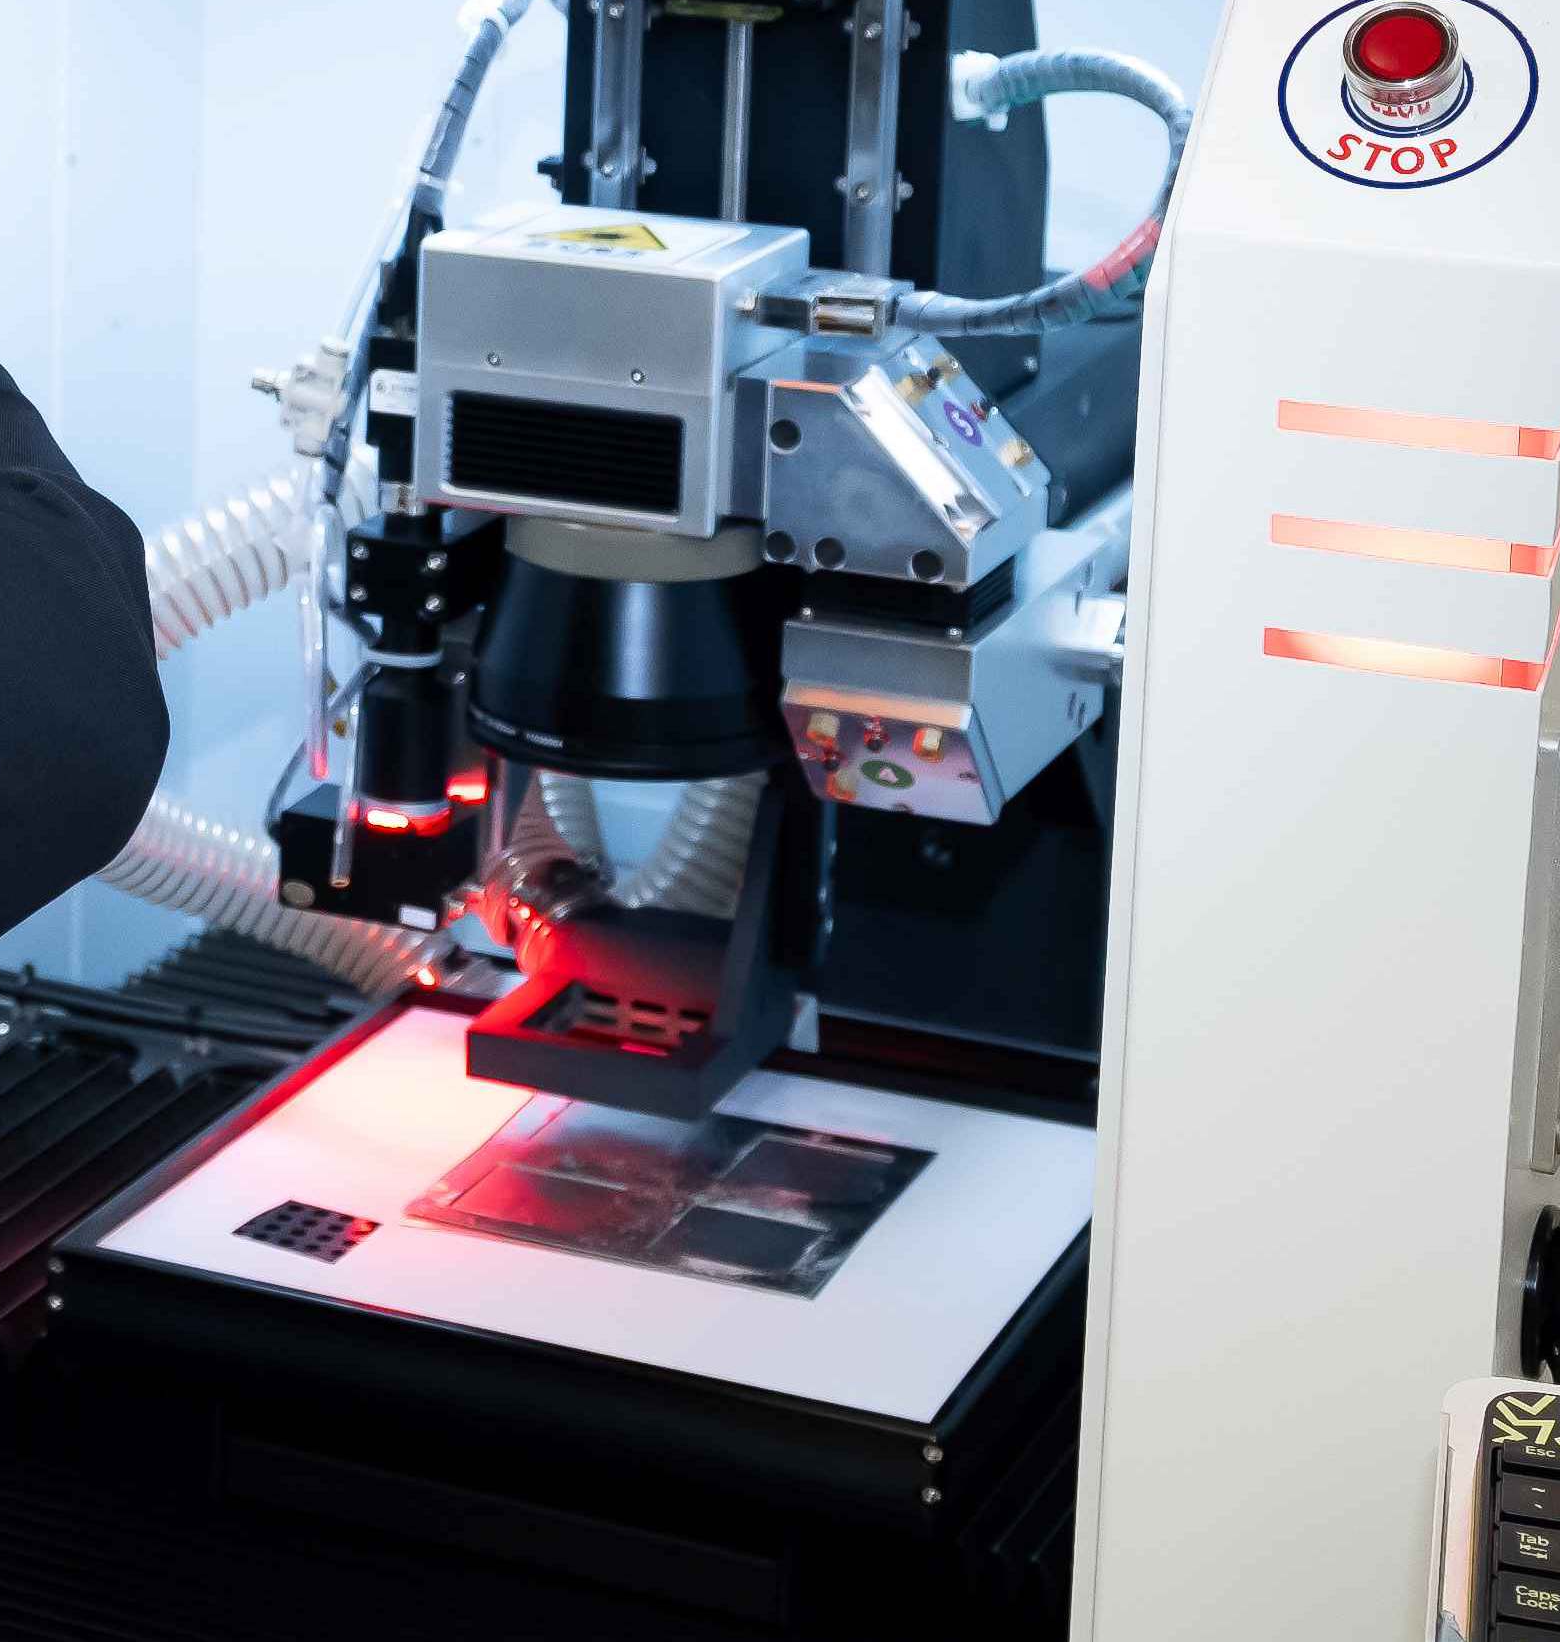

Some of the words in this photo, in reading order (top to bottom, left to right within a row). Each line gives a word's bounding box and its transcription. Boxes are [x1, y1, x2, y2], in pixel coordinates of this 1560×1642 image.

[1326, 133, 1458, 175] STOP
[1525, 1444, 1556, 1459] Esc
[1515, 1530, 1550, 1547] Tab
[1515, 1594, 1560, 1611] Lock
